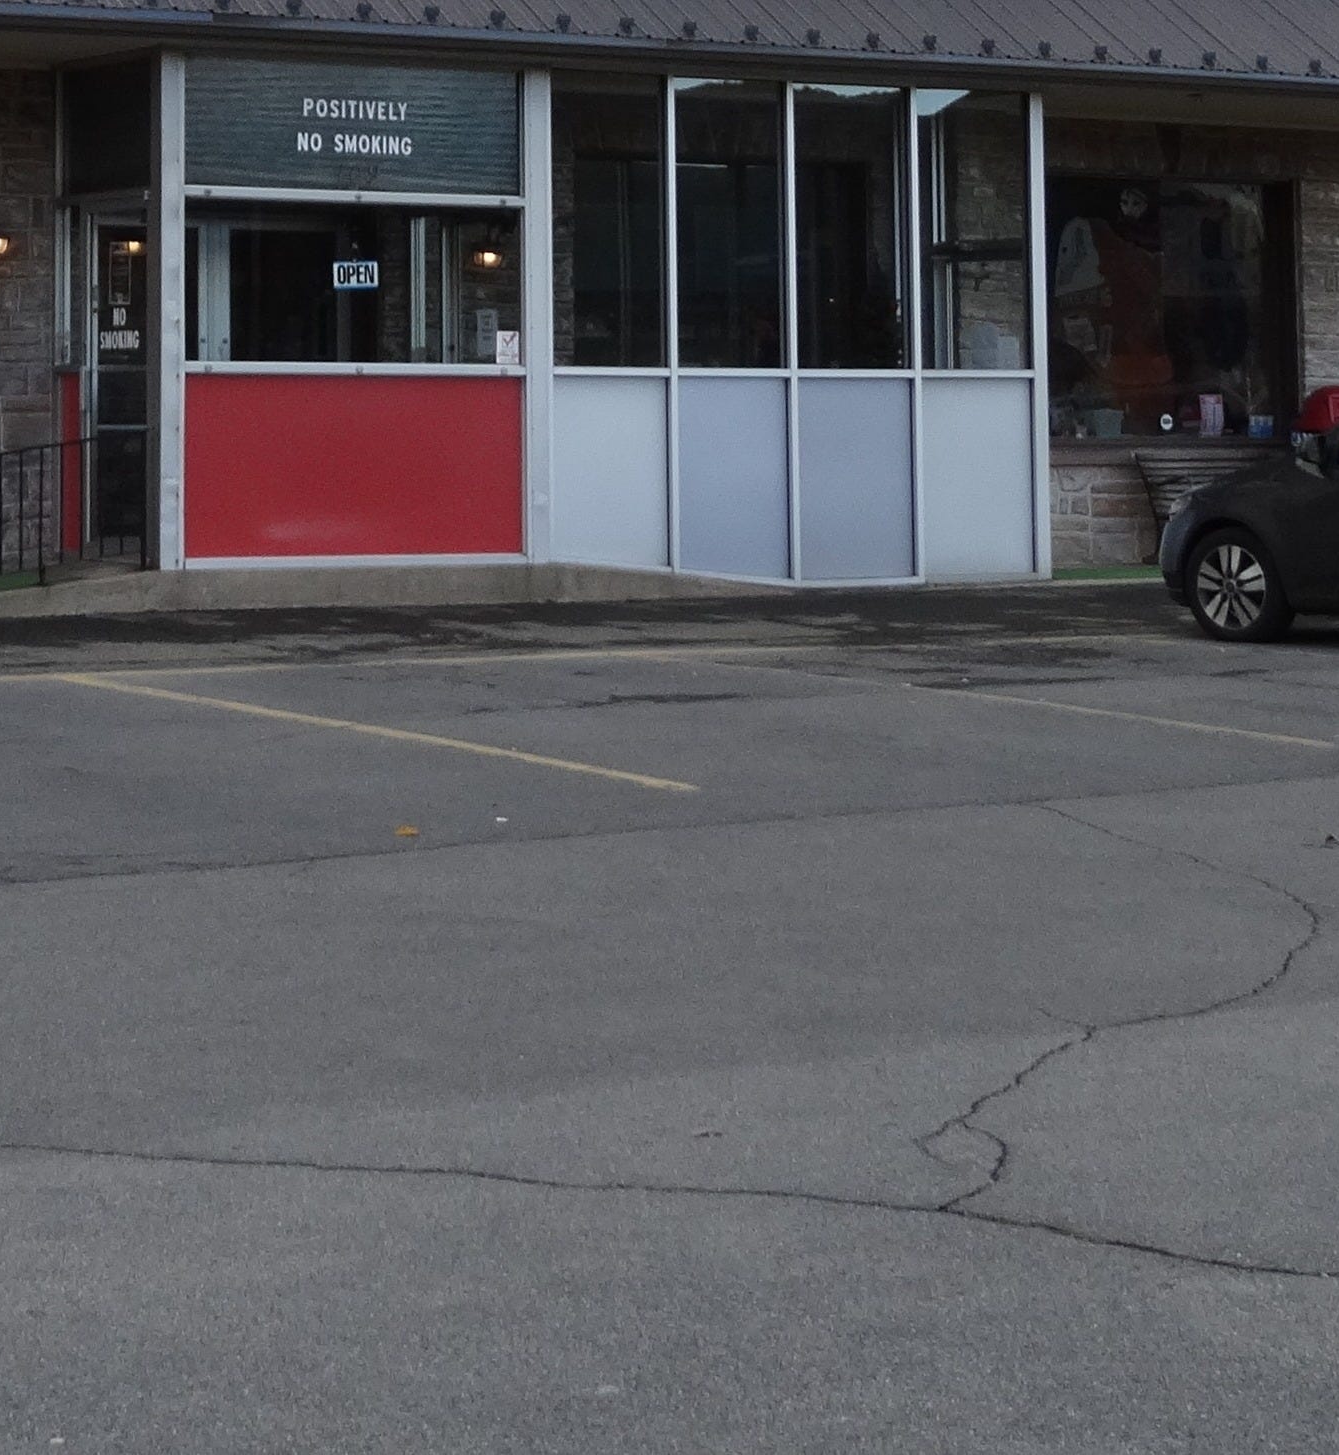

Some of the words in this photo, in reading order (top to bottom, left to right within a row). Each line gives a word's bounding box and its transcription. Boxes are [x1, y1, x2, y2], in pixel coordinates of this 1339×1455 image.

[302, 98, 408, 122] POSITIVELY
[297, 132, 322, 152] NO
[334, 134, 413, 156] SMOKING
[337, 264, 376, 286] OPEN
[112, 307, 127, 327] NO
[99, 330, 140, 350] SMOKING
